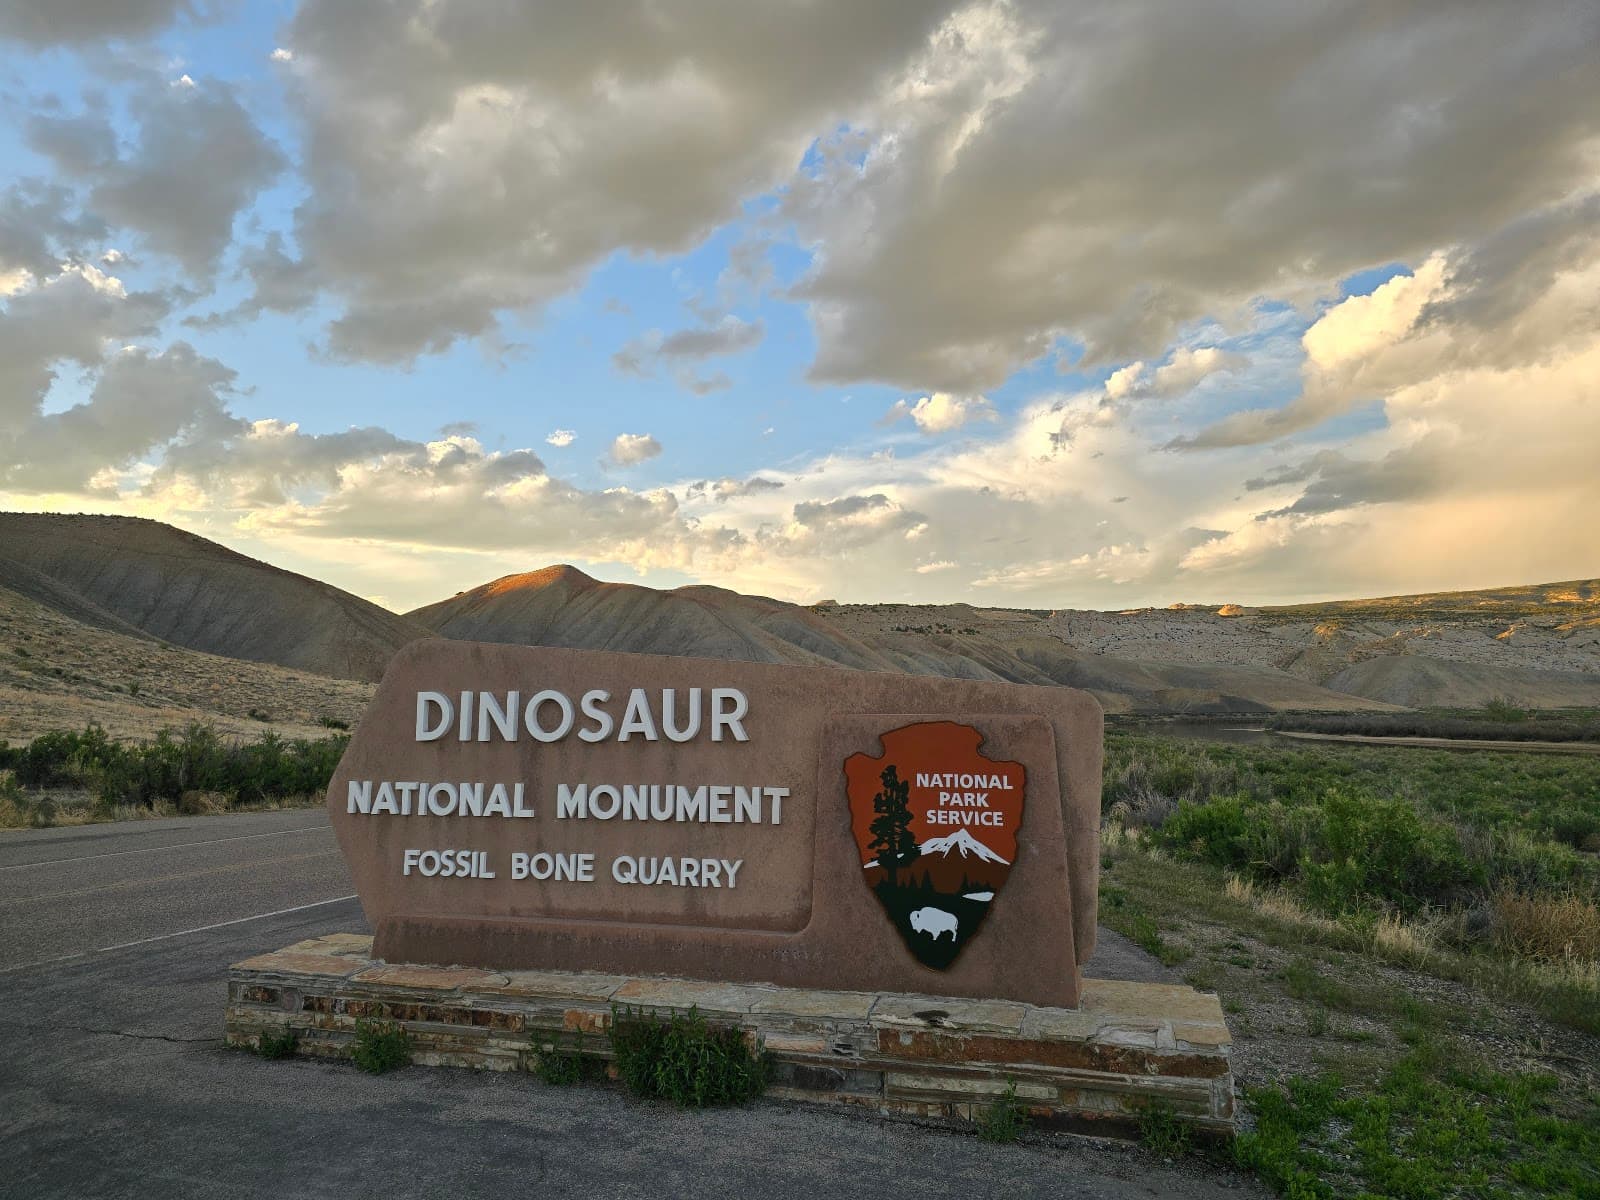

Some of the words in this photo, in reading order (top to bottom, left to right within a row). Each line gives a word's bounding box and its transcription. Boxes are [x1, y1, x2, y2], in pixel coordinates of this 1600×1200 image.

[415, 688, 750, 742] DINOSAUR
[916, 773, 1014, 790] NATIONAL
[347, 780, 535, 818] NATIONAL
[556, 783, 790, 825] MONUMENT
[939, 791, 989, 807] PARK
[926, 809, 1004, 826] SERVICE
[403, 849, 496, 879] FOSSIL
[511, 852, 595, 882] BONE
[612, 855, 744, 889] QUARRY
